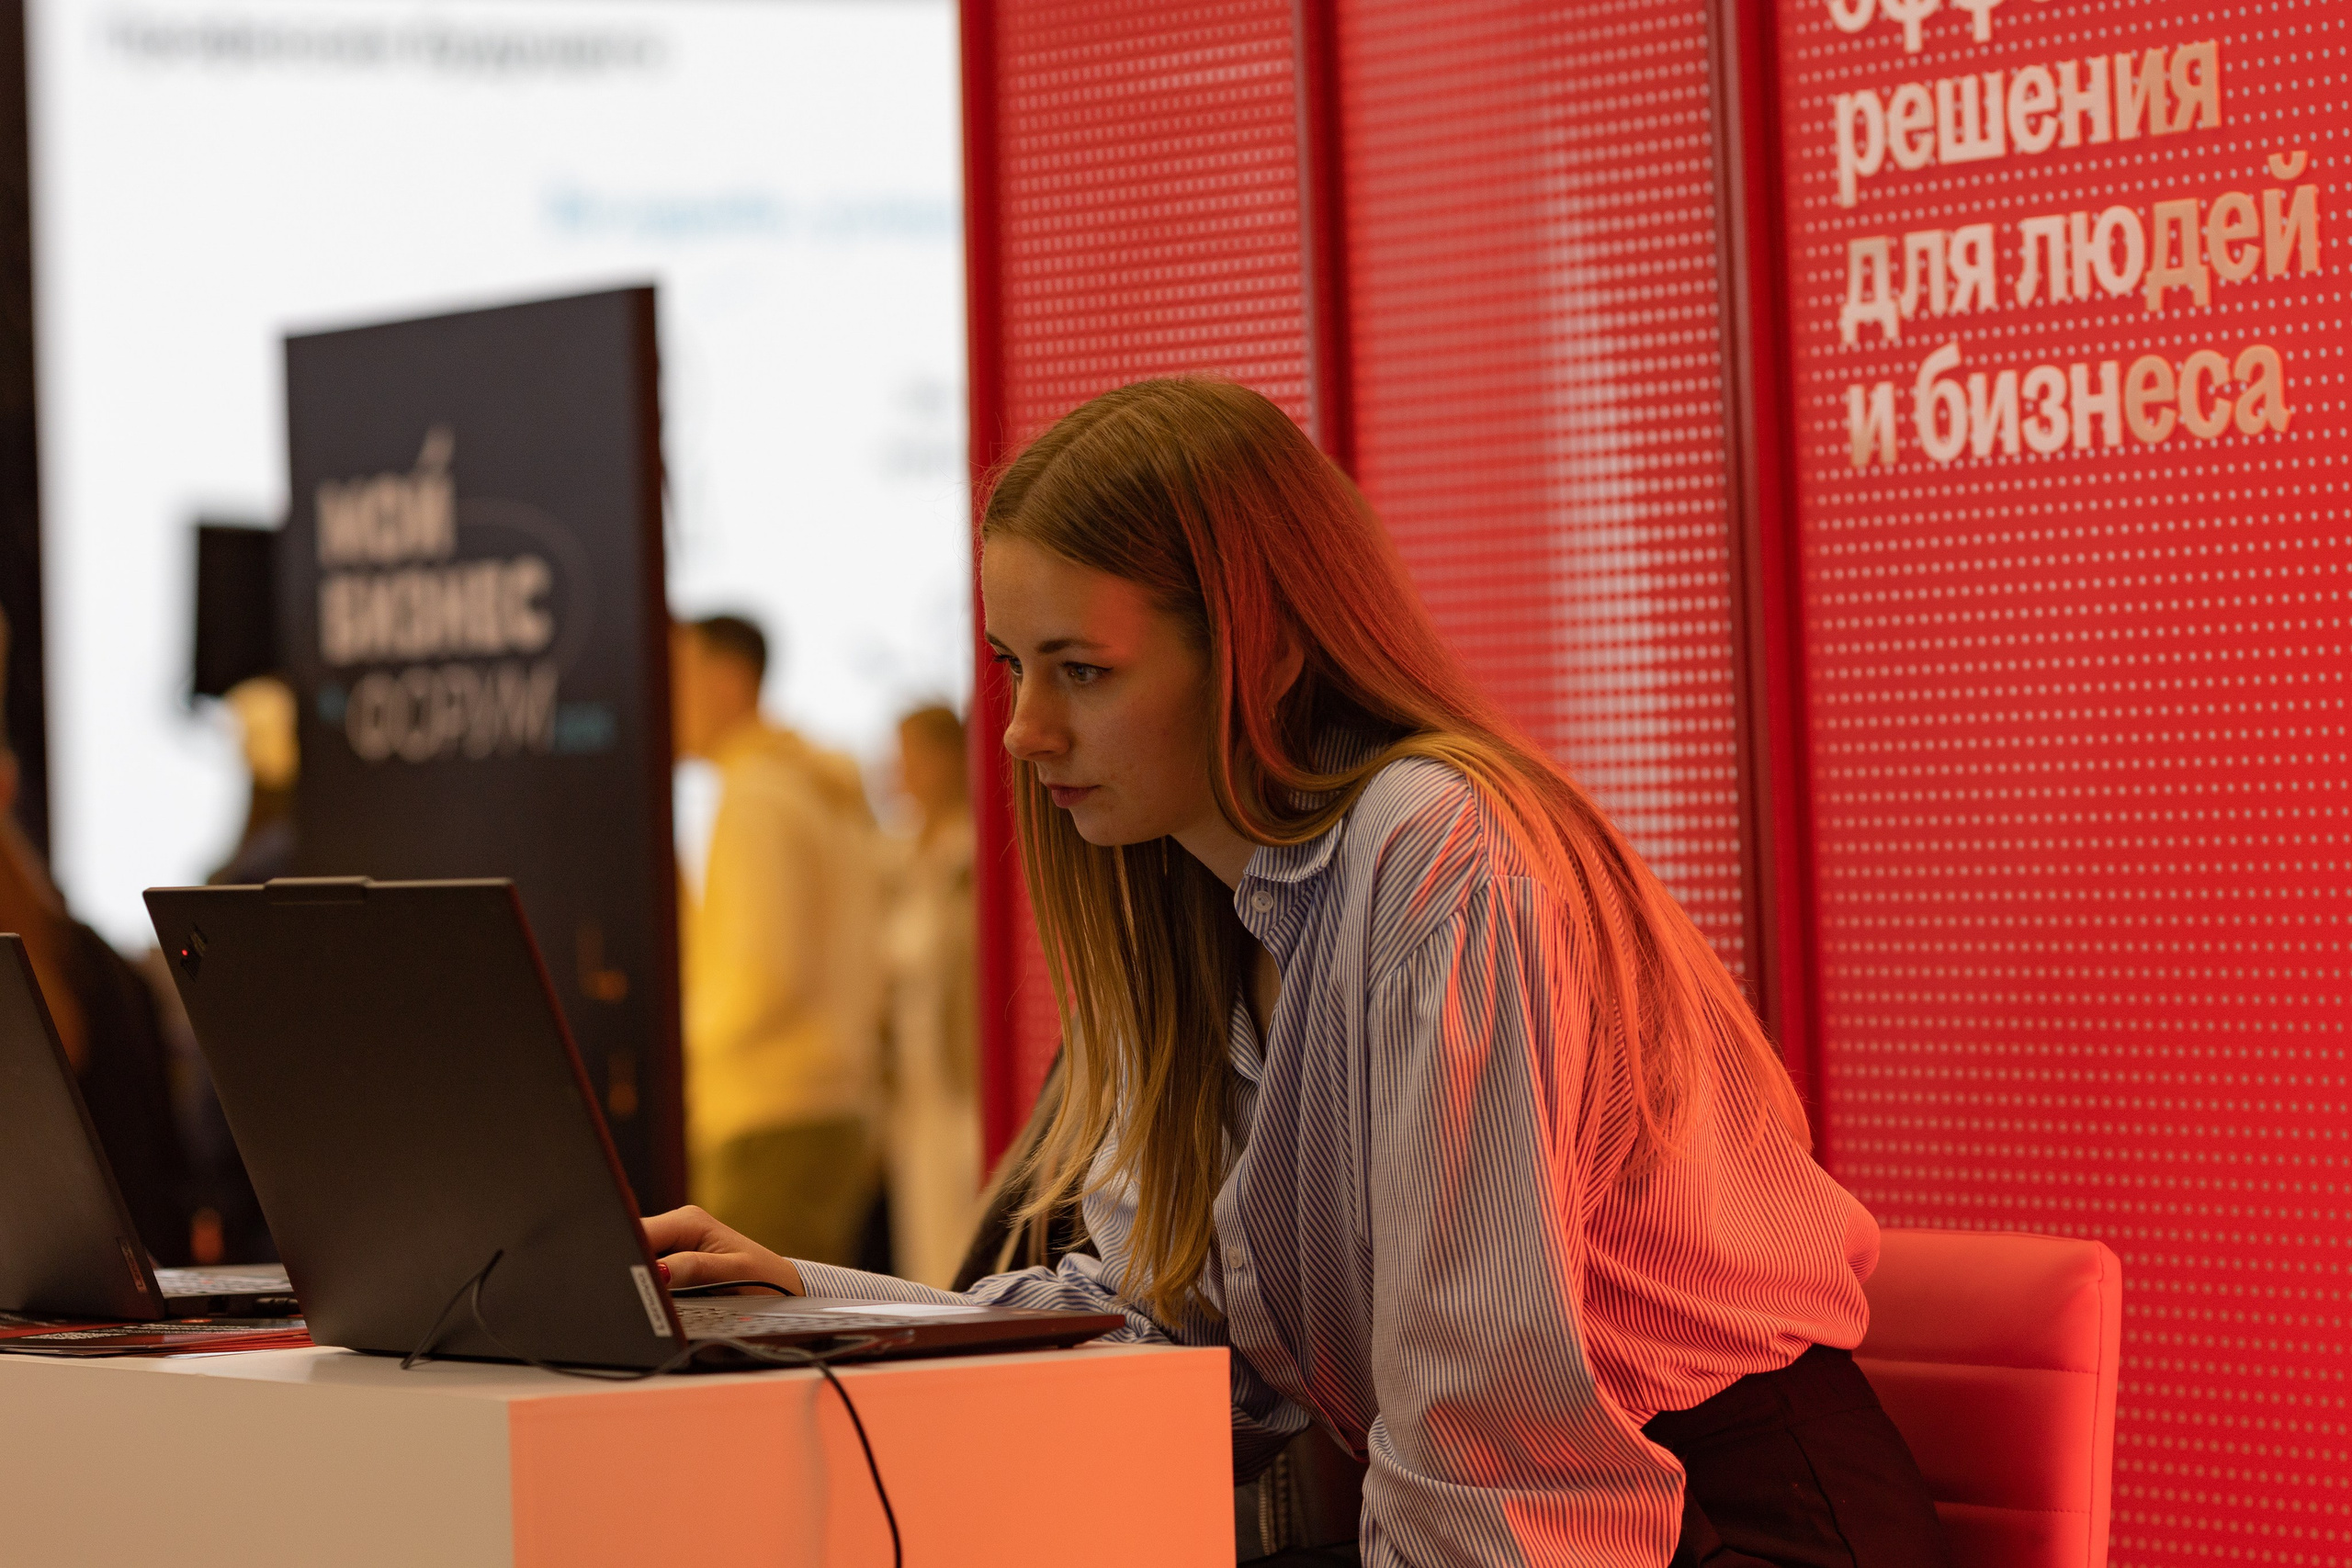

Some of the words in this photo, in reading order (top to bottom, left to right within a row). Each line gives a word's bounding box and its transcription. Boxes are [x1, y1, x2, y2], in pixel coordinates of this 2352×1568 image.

[1837, 40, 2222, 209] решения
[1840, 223, 1997, 345] для
[2016, 150, 2322, 311] людей
[1848, 380, 1896, 468] и
[1915, 340, 2290, 462] бизнеса
[317, 425, 456, 564] МОЙ
[321, 556, 551, 667] БИЗНЕС
[345, 660, 558, 762] ФОРУМ
